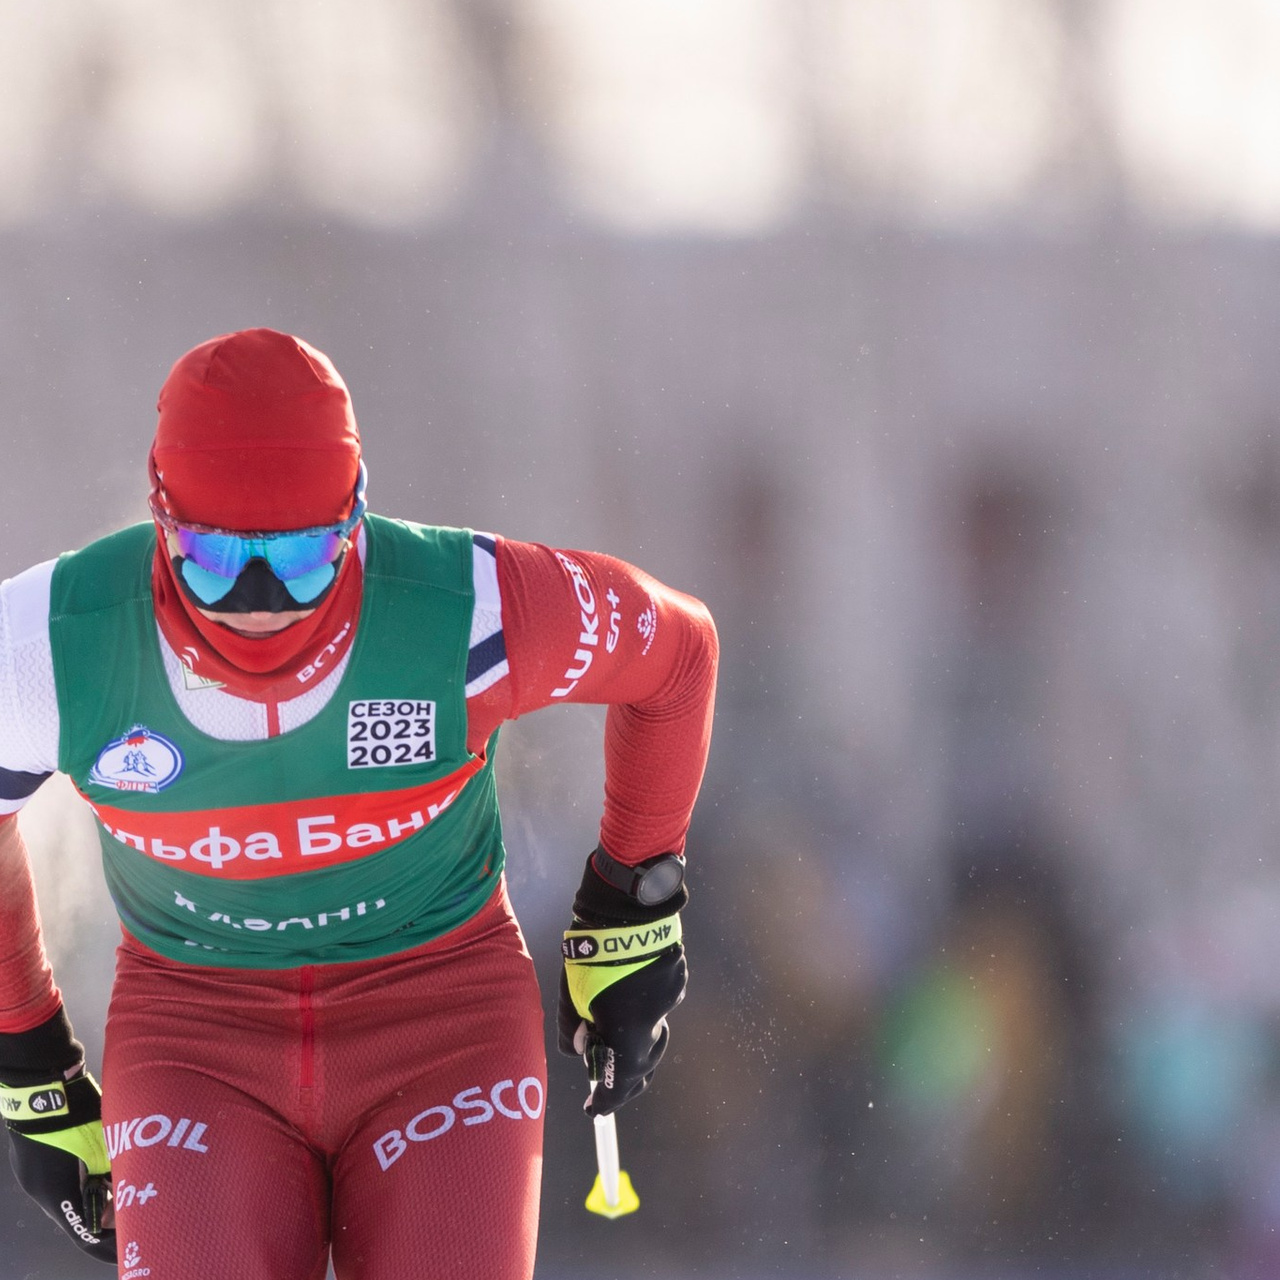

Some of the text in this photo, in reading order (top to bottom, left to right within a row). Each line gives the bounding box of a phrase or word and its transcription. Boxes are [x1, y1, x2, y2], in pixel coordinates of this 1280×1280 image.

[349, 718, 431, 742] 2023
[350, 701, 431, 718] СЕЗОН
[349, 740, 434, 767] 2024
[91, 789, 461, 869] льфа Банк
[604, 1046, 615, 1089] adidas
[372, 1076, 543, 1172] BOSCO
[60, 1200, 101, 1245] adidas
